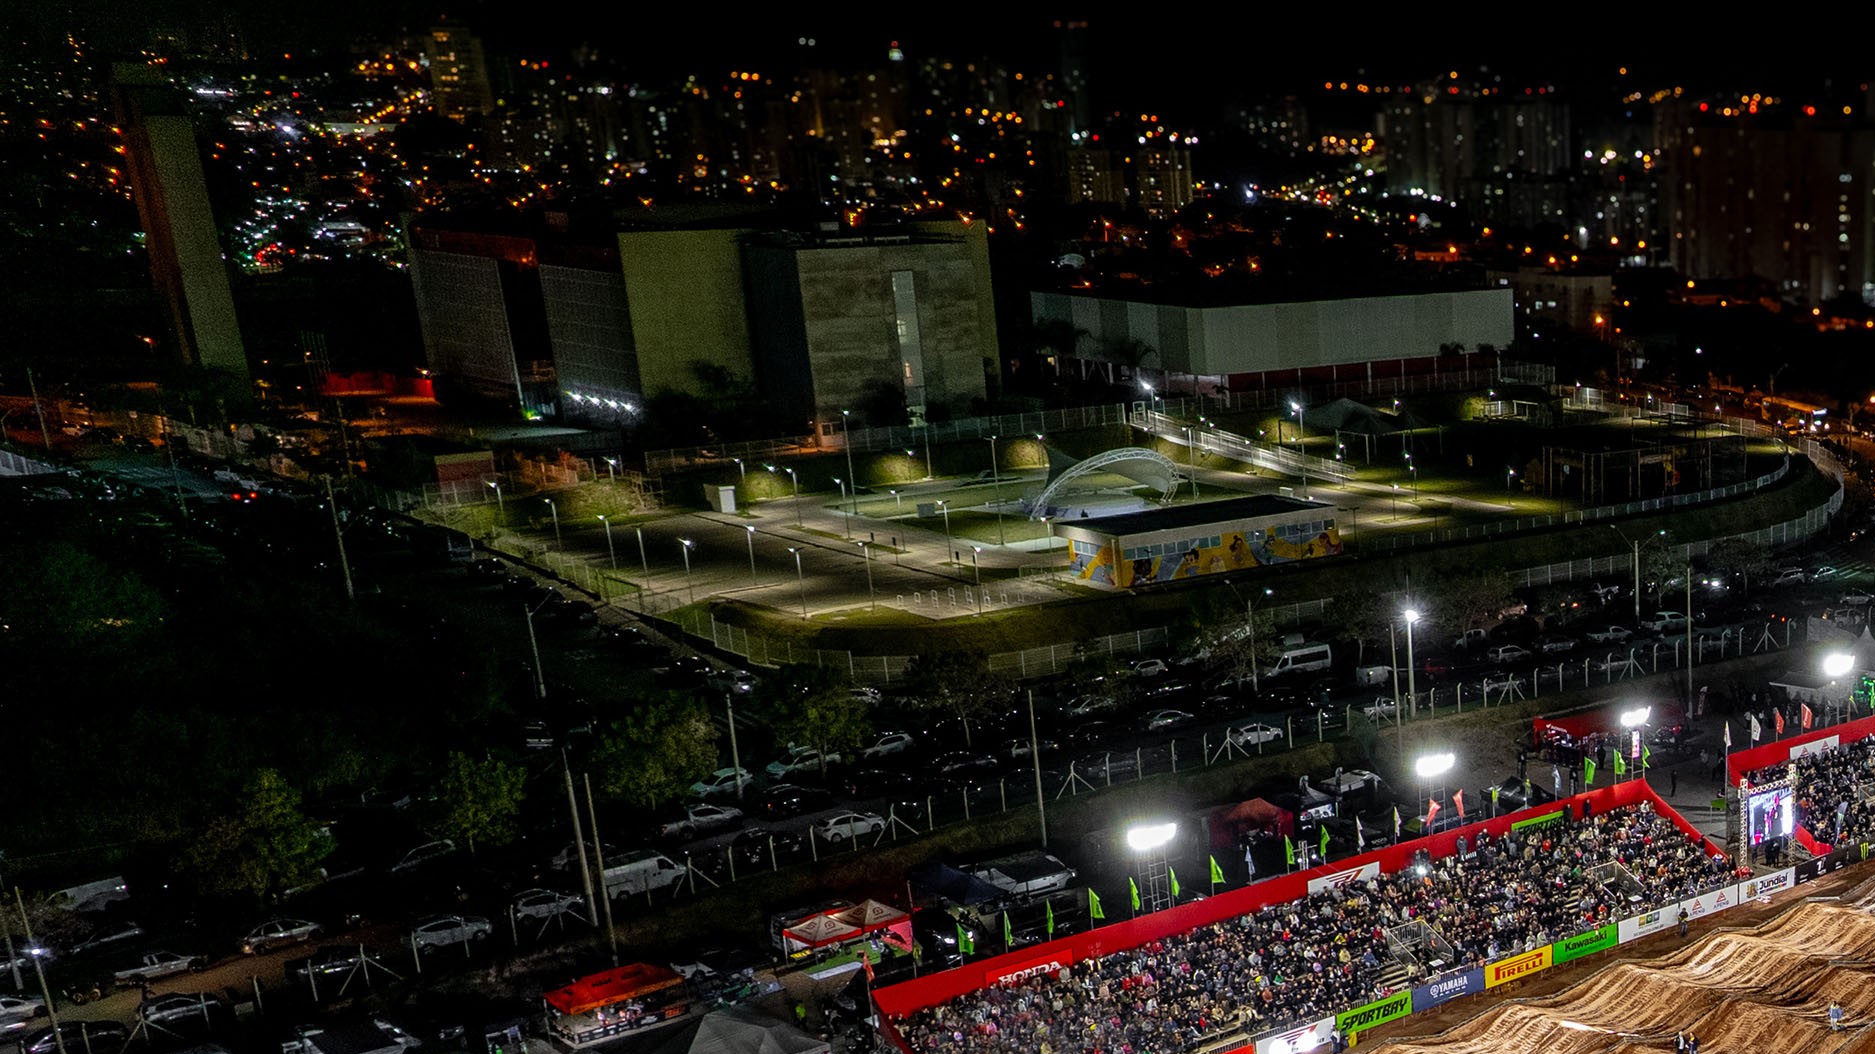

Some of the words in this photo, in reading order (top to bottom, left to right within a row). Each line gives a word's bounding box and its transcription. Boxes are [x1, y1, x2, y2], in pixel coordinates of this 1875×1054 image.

[1564, 931, 1608, 952] Kawasaki
[998, 960, 1062, 985] HONDA
[1494, 952, 1544, 981] PIRELLI
[1437, 975, 1468, 995] YAMAHA
[1341, 997, 1409, 1032] SPORTBAY
